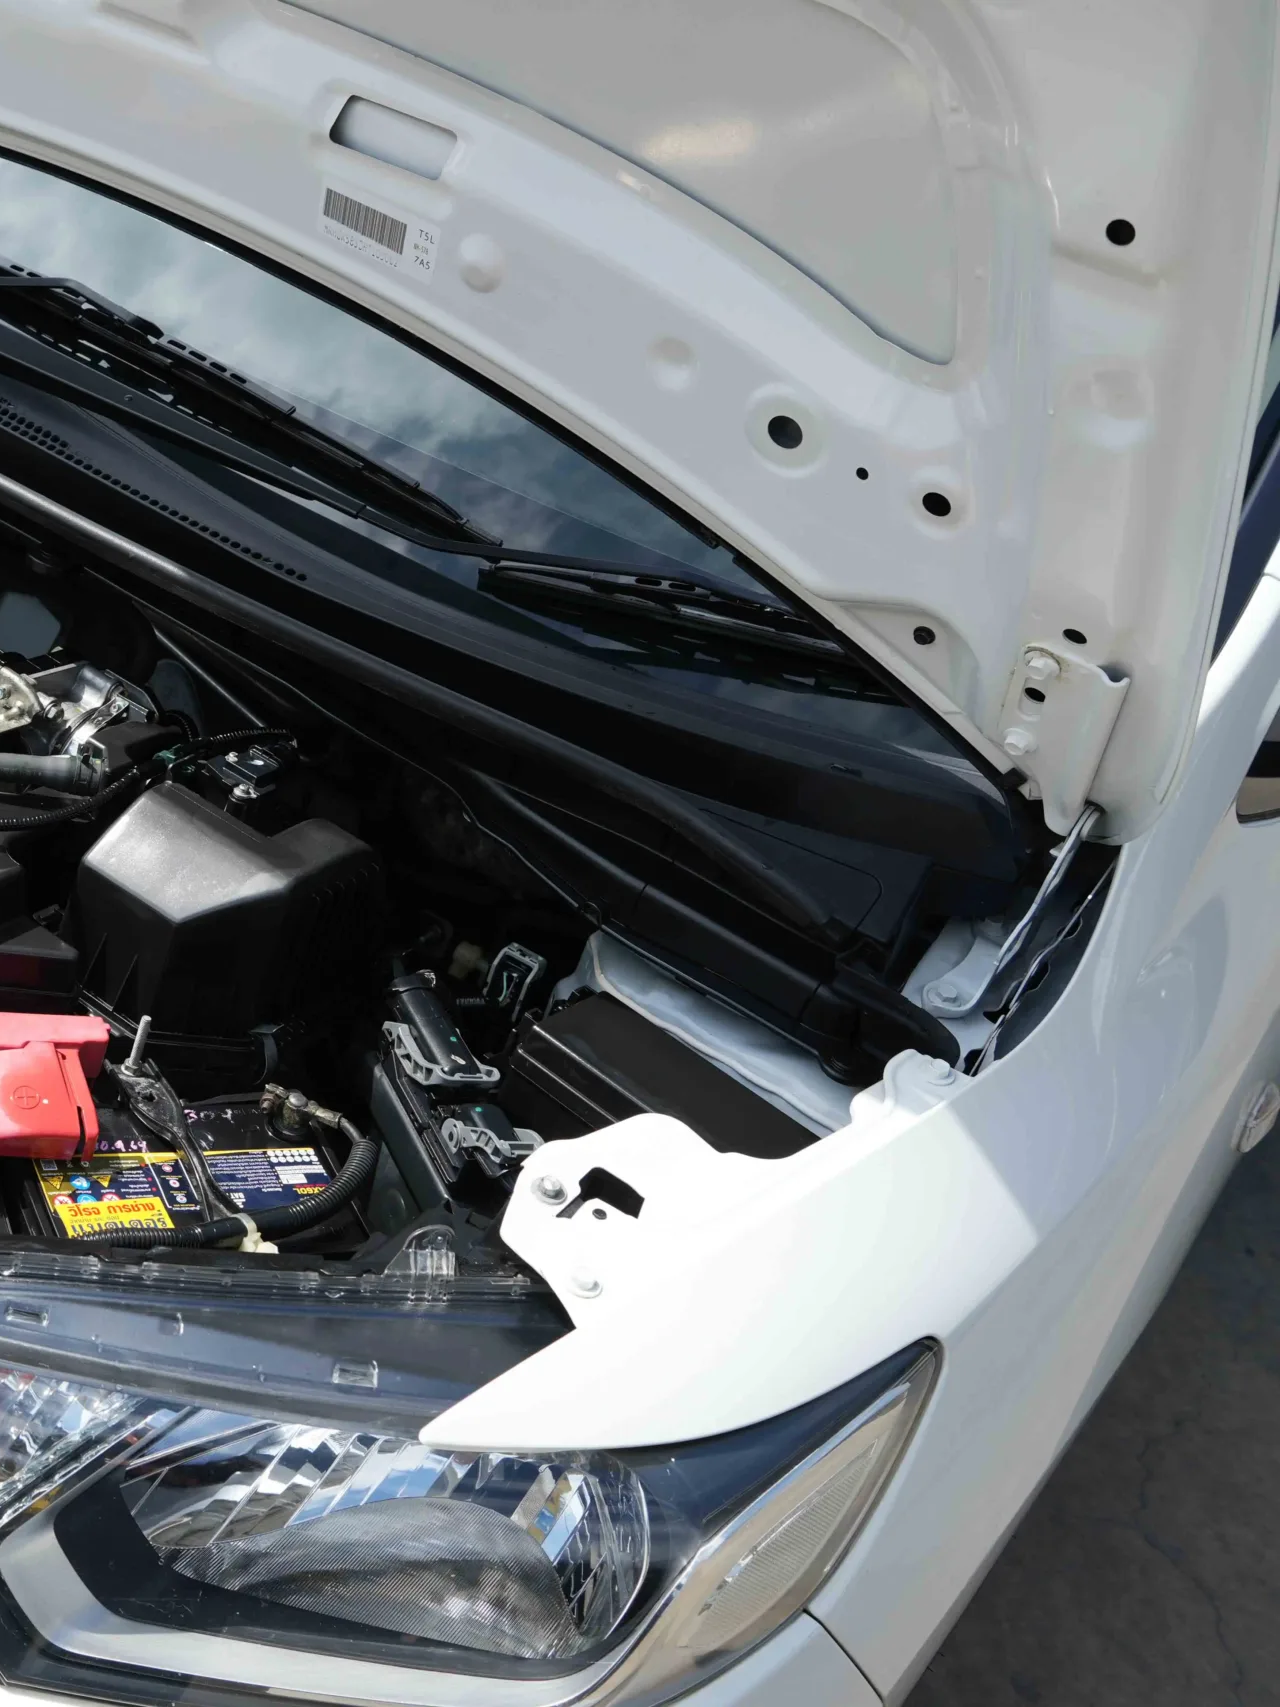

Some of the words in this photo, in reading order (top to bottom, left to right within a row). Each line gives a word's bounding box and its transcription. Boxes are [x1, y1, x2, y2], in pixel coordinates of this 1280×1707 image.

[67, 1204, 101, 1217] วิโรจ
[107, 1201, 156, 1214] การช่าง
